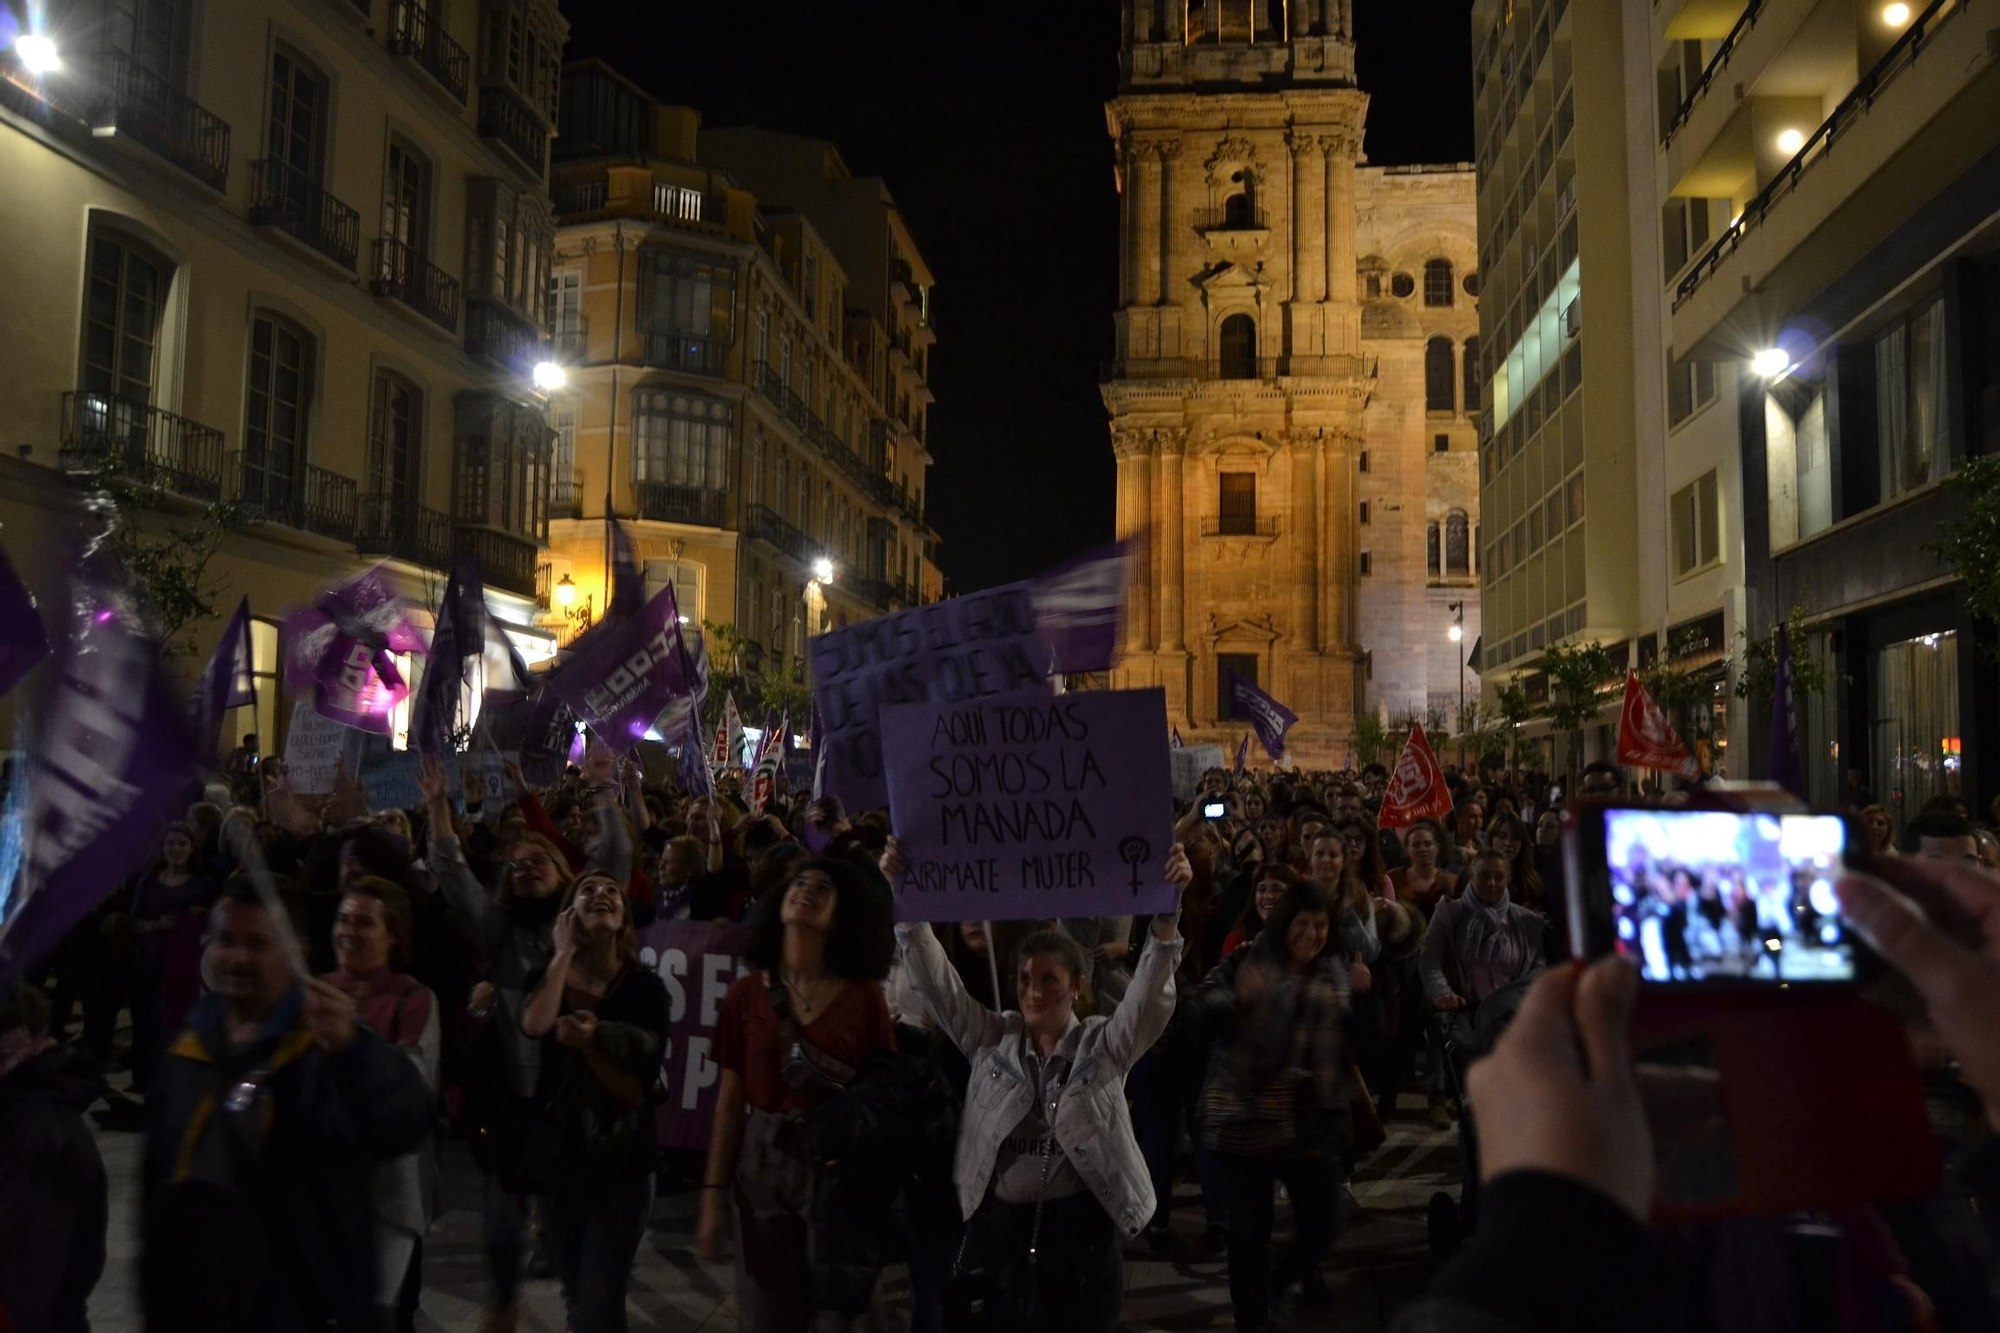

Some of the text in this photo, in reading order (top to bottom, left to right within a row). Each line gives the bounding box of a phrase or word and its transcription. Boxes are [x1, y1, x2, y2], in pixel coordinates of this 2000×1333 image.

[991, 702, 1089, 745] TODAS
[929, 748, 1107, 799] SOMOS LA
[941, 798, 1097, 846] MANADA
[1021, 852, 1095, 890] MUJER
